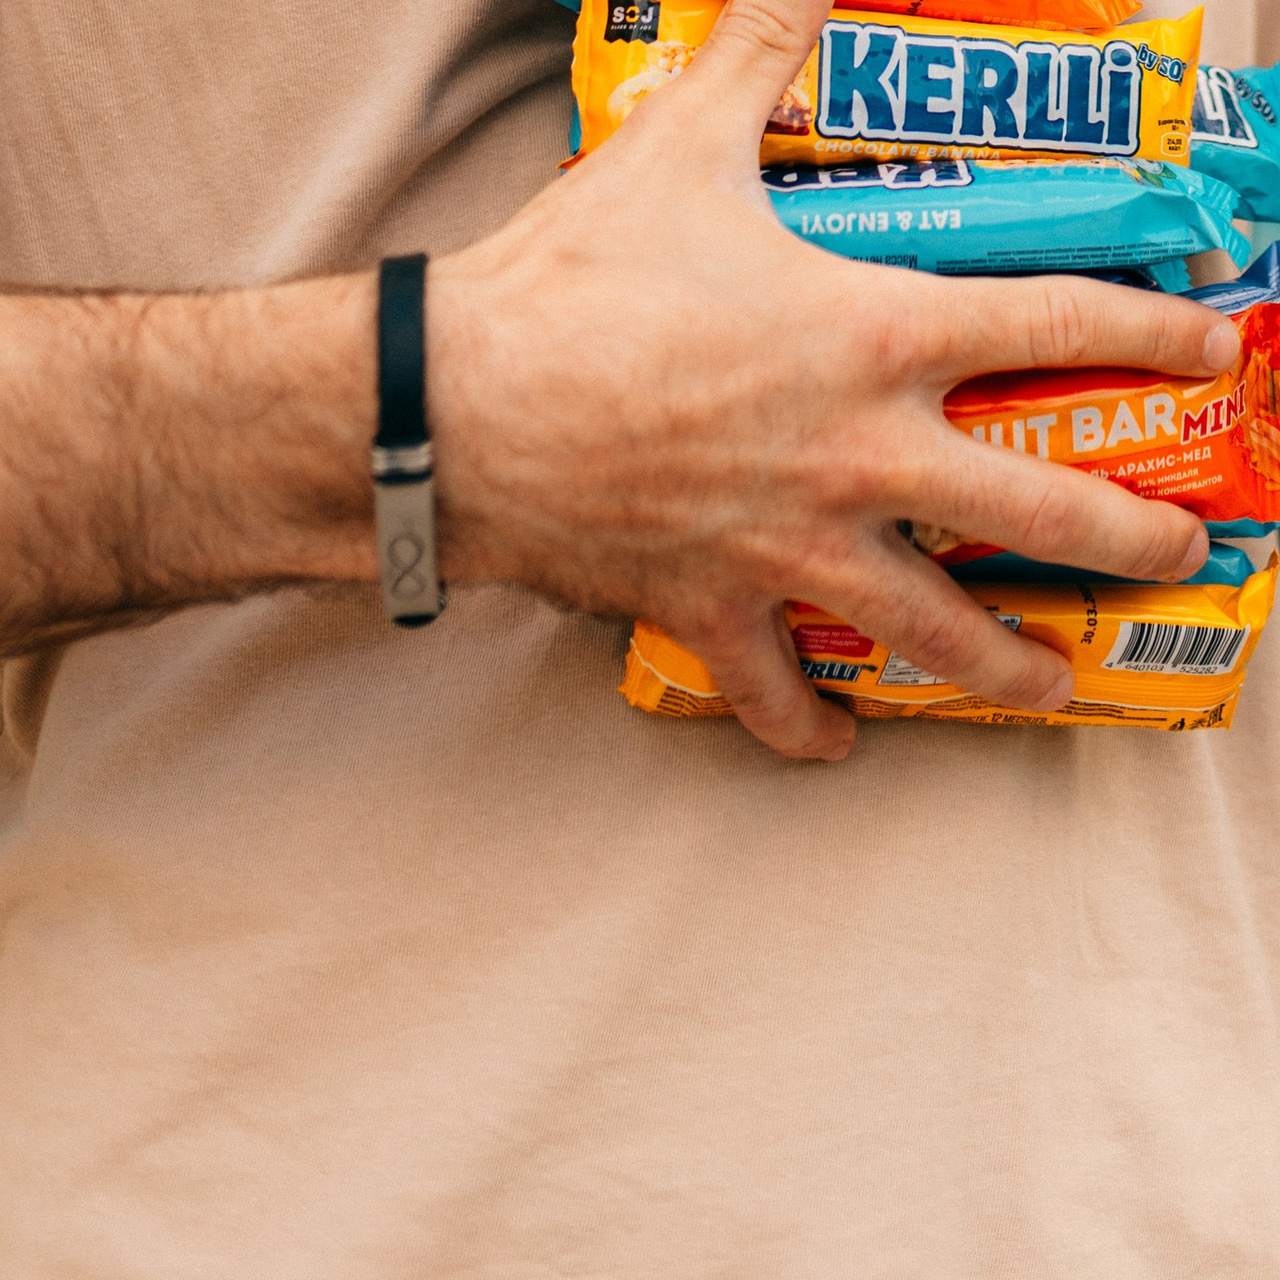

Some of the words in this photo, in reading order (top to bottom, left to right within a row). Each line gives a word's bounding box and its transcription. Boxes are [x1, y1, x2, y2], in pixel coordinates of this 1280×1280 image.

[612, 5, 654, 23] SOJ
[1137, 43, 1158, 70] by
[1158, 55, 1187, 86] SO
[814, 140, 1000, 160] CHOCOLATE-BANANA
[801, 212, 889, 235] ENJOY!
[895, 212, 913, 231] &
[919, 209, 961, 230] EAT
[885, 254, 918, 269] Масса
[1180, 379, 1247, 445] MINI
[1071, 393, 1177, 454] BAR
[1157, 468, 1199, 485] МИНДАЛЯ
[1157, 475, 1223, 496] КОНСЕРВАНТОВ
[1105, 661, 1113, 669] 4
[1125, 663, 1165, 672] 640103
[1180, 666, 1218, 674] 525282
[991, 713, 1003, 723] 12
